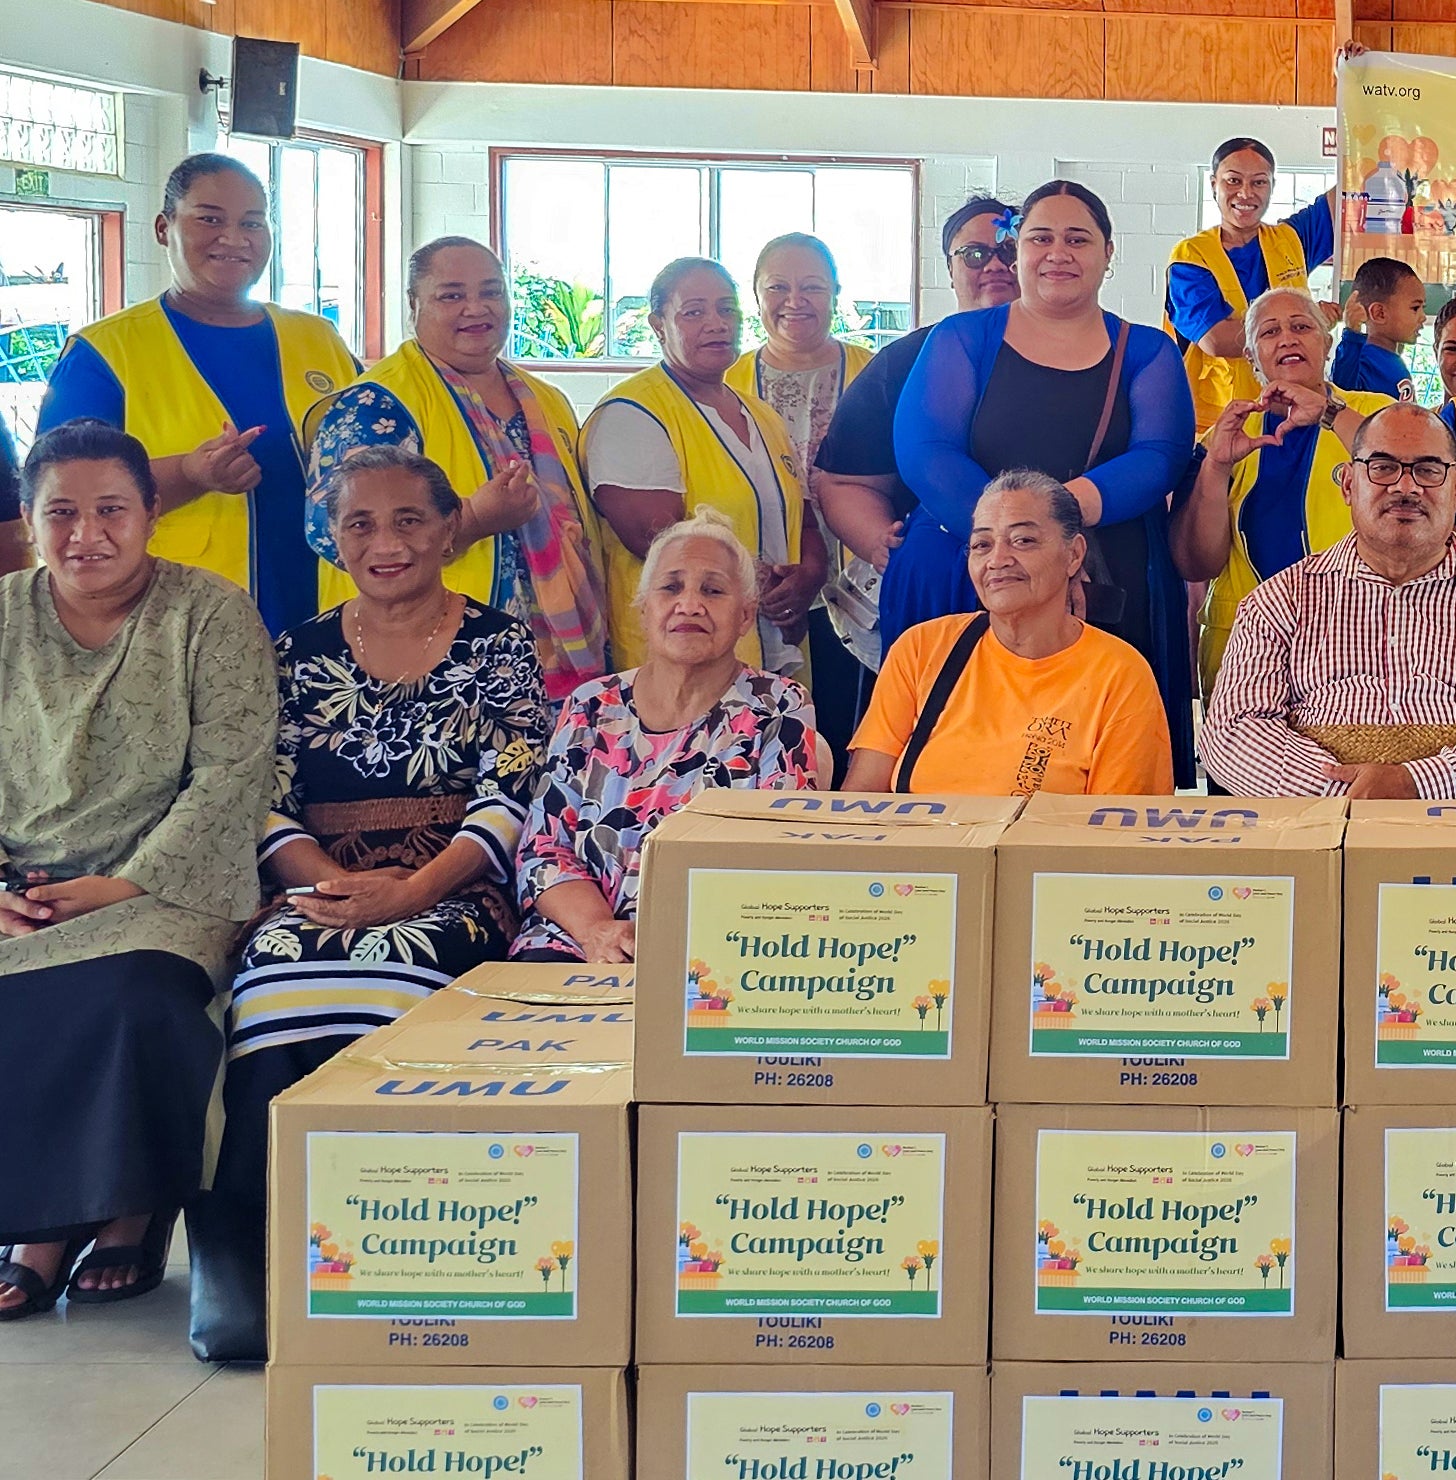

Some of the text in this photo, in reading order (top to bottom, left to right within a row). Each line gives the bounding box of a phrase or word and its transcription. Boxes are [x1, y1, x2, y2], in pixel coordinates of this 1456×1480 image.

[1363, 84, 1421, 100] watv.org
[22, 172, 43, 191] EXIT
[769, 797, 947, 814] UMU
[1088, 807, 1259, 828] UMU
[778, 831, 888, 841] PAK
[1138, 835, 1242, 844] PAK
[1104, 905, 1124, 915] Hope
[1126, 905, 1170, 915] Supporters
[726, 931, 916, 966] “Hold Hope!”
[1070, 935, 1254, 969] “Hold Hope!”
[562, 975, 634, 988] PA
[741, 968, 894, 1000] Campaign
[1084, 971, 1234, 1003] Campaign
[1081, 1008, 1094, 1016] We
[1096, 1008, 1120, 1016] share
[1121, 1008, 1143, 1017] hope
[1144, 1008, 1163, 1016] with
[466, 1039, 578, 1052] PAK
[1078, 1037, 1241, 1047] WORLD MISSION SOCIETY CHURCH OF GOD
[754, 1072, 834, 1088] PH: 26208
[1120, 1072, 1198, 1086] PH: 26208
[374, 1079, 571, 1097] UMU
[347, 1197, 537, 1229] “Hold Hope!”
[716, 1195, 904, 1228] “Hold Hope!”
[1074, 1194, 1257, 1228] “Hold Hope!”
[362, 1231, 516, 1263] Campaign
[731, 1230, 884, 1262] Campaign
[1089, 1230, 1238, 1261] Campaign
[388, 1333, 469, 1347] PH: 26208
[756, 1335, 834, 1349] PH: 26208
[1109, 1331, 1186, 1346] PH: 26208
[353, 1447, 542, 1479] “Hold Hope!”
